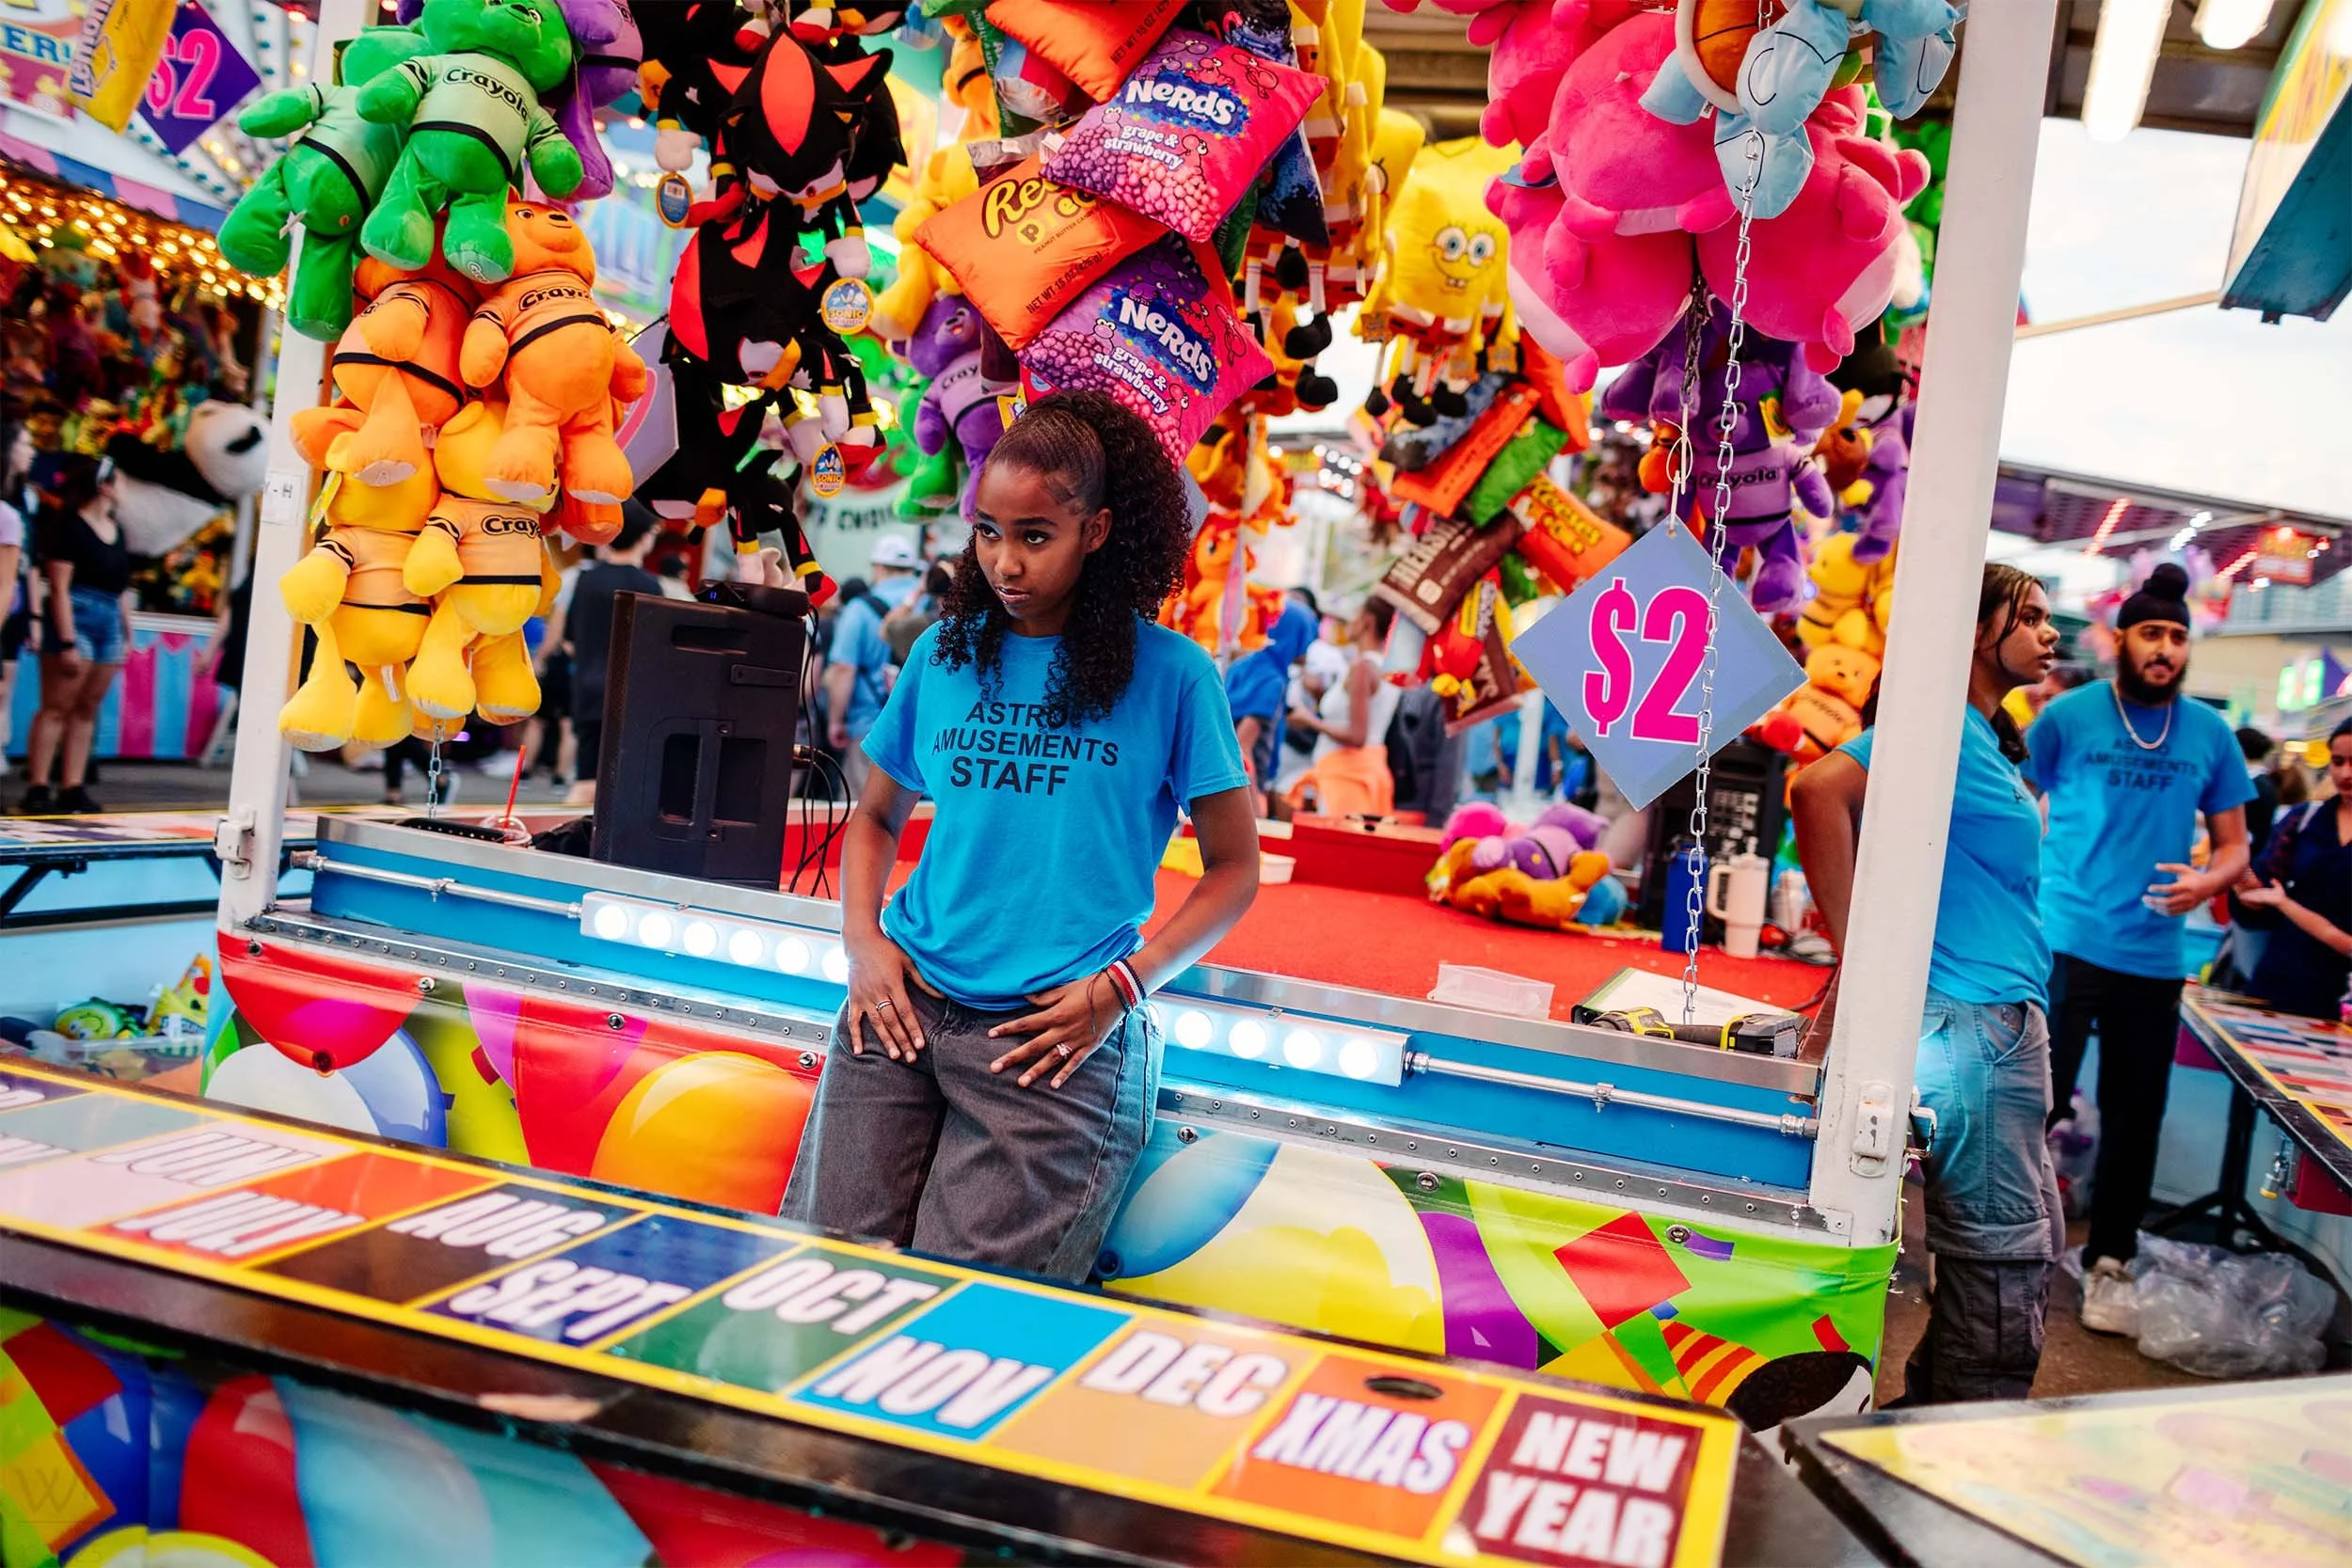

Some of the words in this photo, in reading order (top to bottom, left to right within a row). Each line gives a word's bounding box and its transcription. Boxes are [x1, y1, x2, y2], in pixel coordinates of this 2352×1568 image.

[443, 68, 529, 125] Crayola
[1103, 138, 1184, 171] strawberry
[1120, 125, 1165, 143] grape
[1164, 133, 1179, 149] &
[828, 309, 864, 319] SONIC
[1025, 297, 1043, 314] NET
[1041, 286, 1057, 302] WT
[1064, 268, 1078, 282] OZ
[1093, 352, 1170, 414] strawberry
[1112, 346, 1155, 378] grape
[1153, 375, 1168, 391] &
[816, 473, 841, 483] SONIC
[1581, 576, 1715, 747] $2
[931, 729, 1120, 767] AMUSEMENTS
[949, 756, 1070, 796] STAFF
[2107, 768, 2175, 792] STAFF
[91, 1131, 322, 1188] JUN
[111, 1190, 367, 1258] JULY
[384, 1192, 608, 1260] AUG
[448, 1259, 693, 1343] SEPT
[721, 1257, 943, 1334] OCT
[811, 1334, 1057, 1432] NOV
[1079, 1329, 1288, 1418] DEC
[1252, 1391, 1472, 1496] XMAS
[1509, 1410, 1689, 1495] NEW
[1476, 1471, 1676, 1568] YEAR
